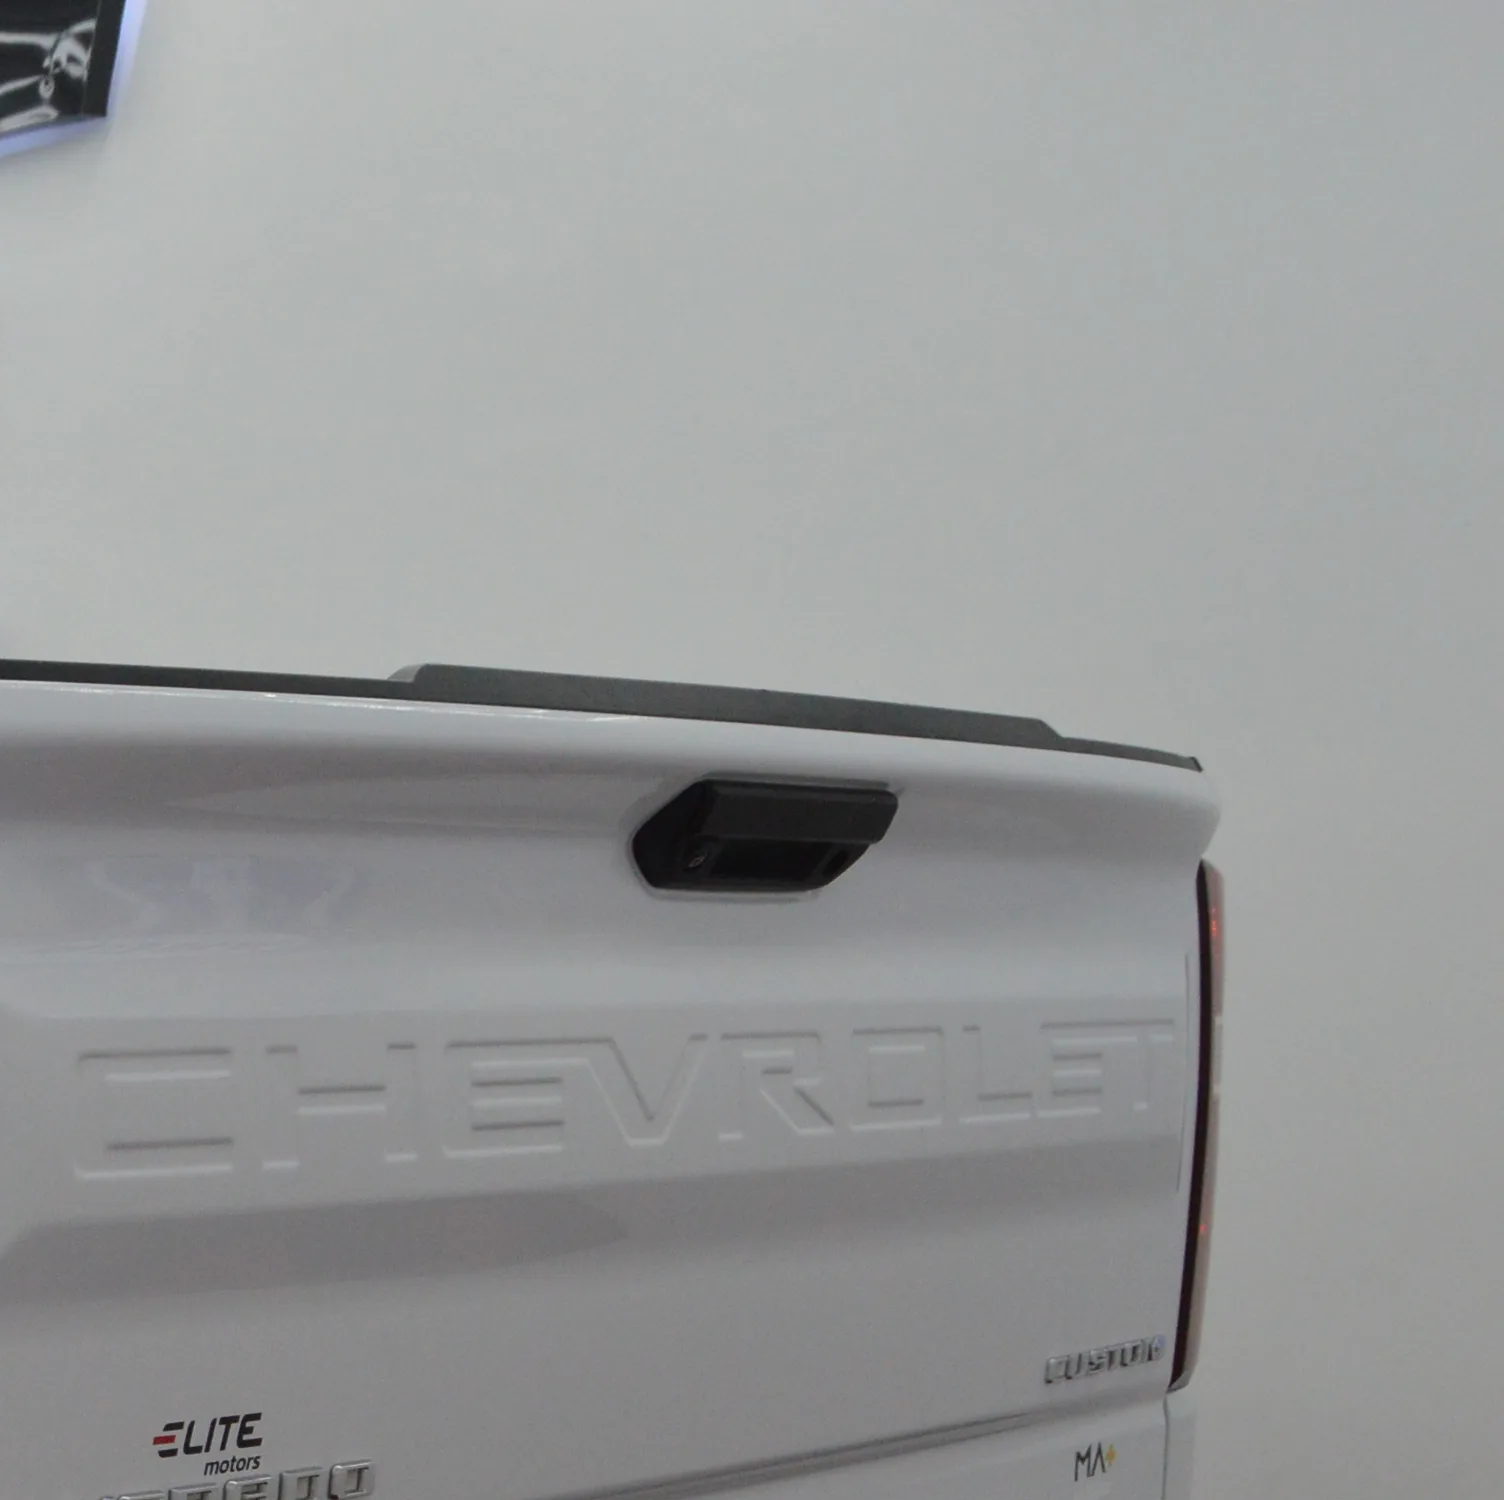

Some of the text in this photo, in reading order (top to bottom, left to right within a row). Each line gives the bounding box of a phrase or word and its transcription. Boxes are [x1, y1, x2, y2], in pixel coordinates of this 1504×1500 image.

[73, 1018, 1175, 1180] CHEVROLET
[1044, 1333, 1168, 1384] CUSTOM
[152, 1412, 263, 1459] ELITE
[203, 1453, 262, 1477] motors
